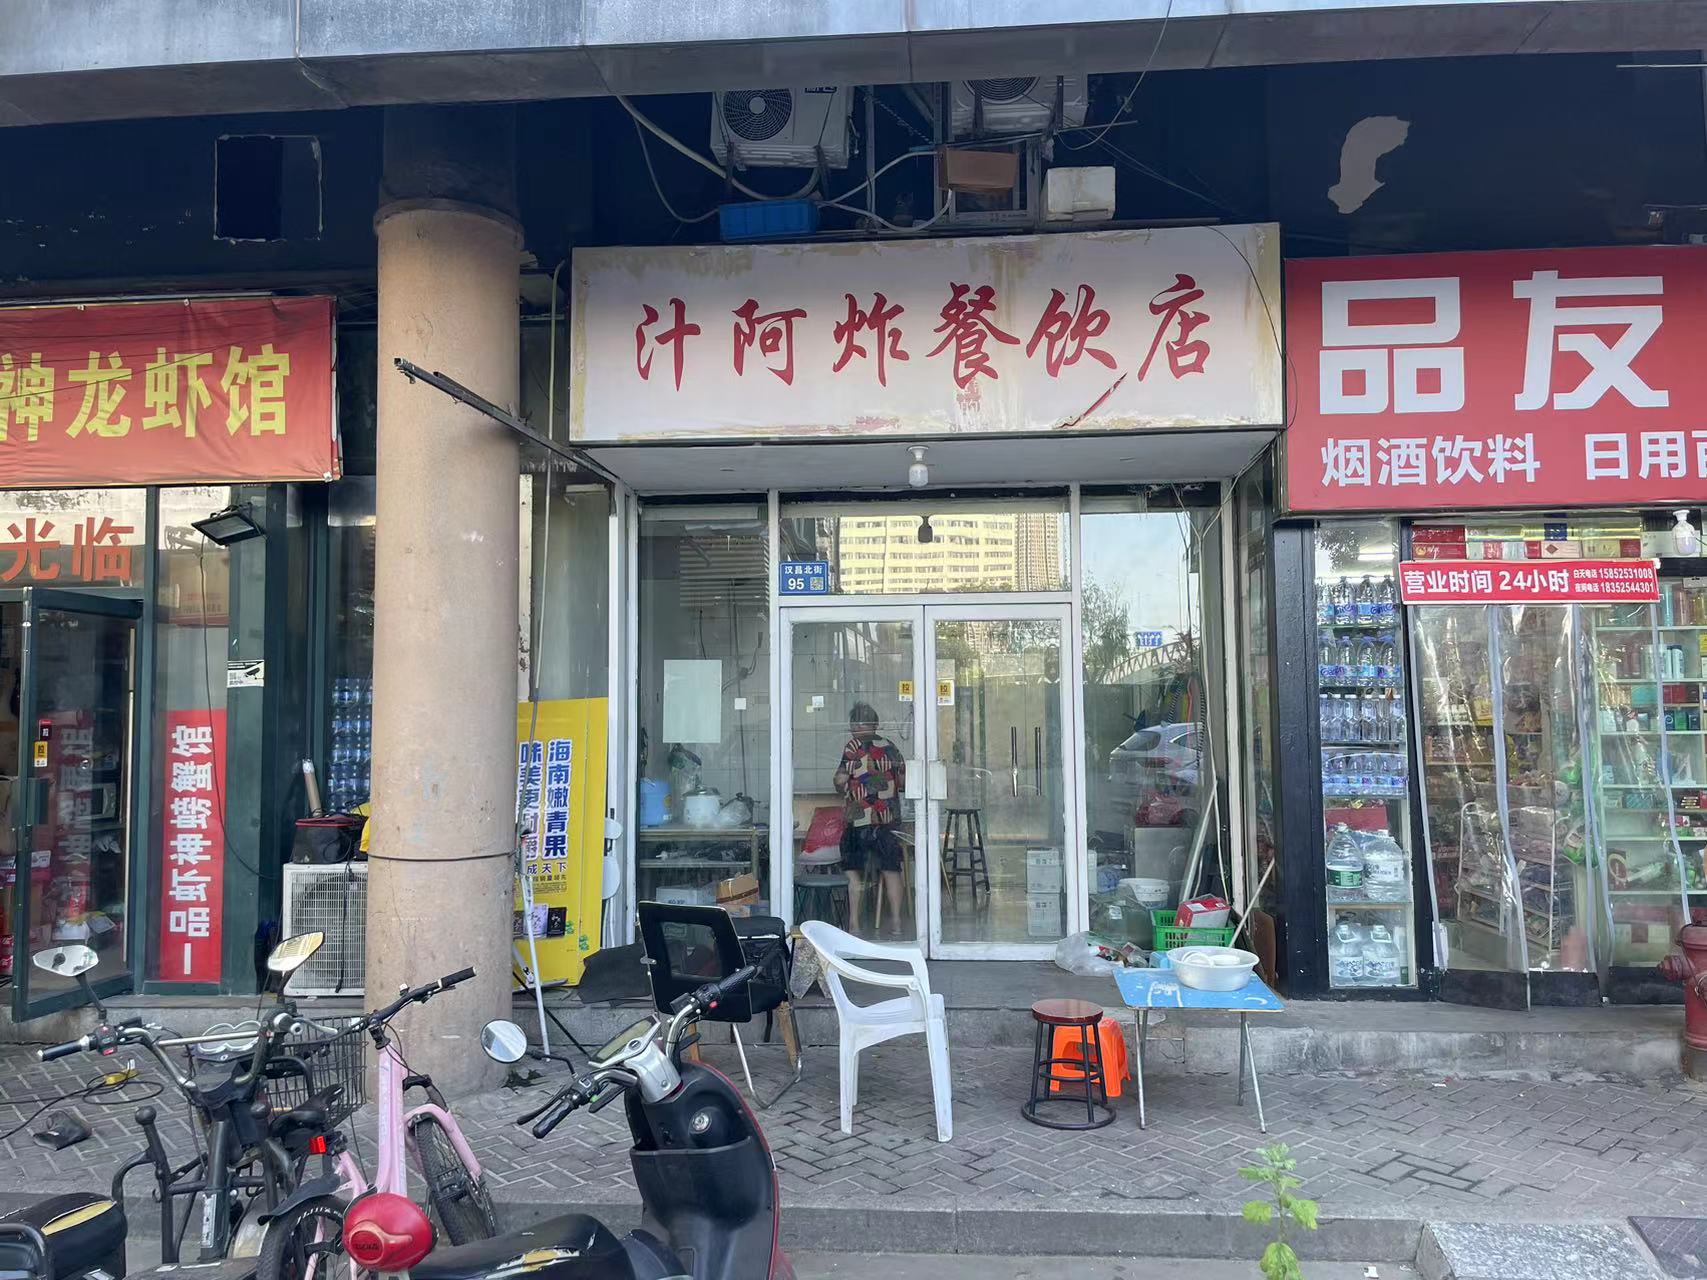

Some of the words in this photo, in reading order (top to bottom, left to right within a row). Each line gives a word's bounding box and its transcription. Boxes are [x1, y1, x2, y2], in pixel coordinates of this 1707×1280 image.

[637, 274, 1213, 391] 汁阿炸餐饮店
[1319, 270, 1669, 415] 品友
[0, 343, 290, 441] 神龙虾馆
[1320, 432, 1541, 487] 烟酒饮料
[0, 518, 134, 583] 光临
[788, 578, 805, 589] 95
[1404, 570, 1493, 594] 营业时间
[1498, 569, 1570, 593] 24小时
[545, 741, 571, 857] 海南嫩青果
[170, 725, 213, 975] 一品虾神螃蟹馆
